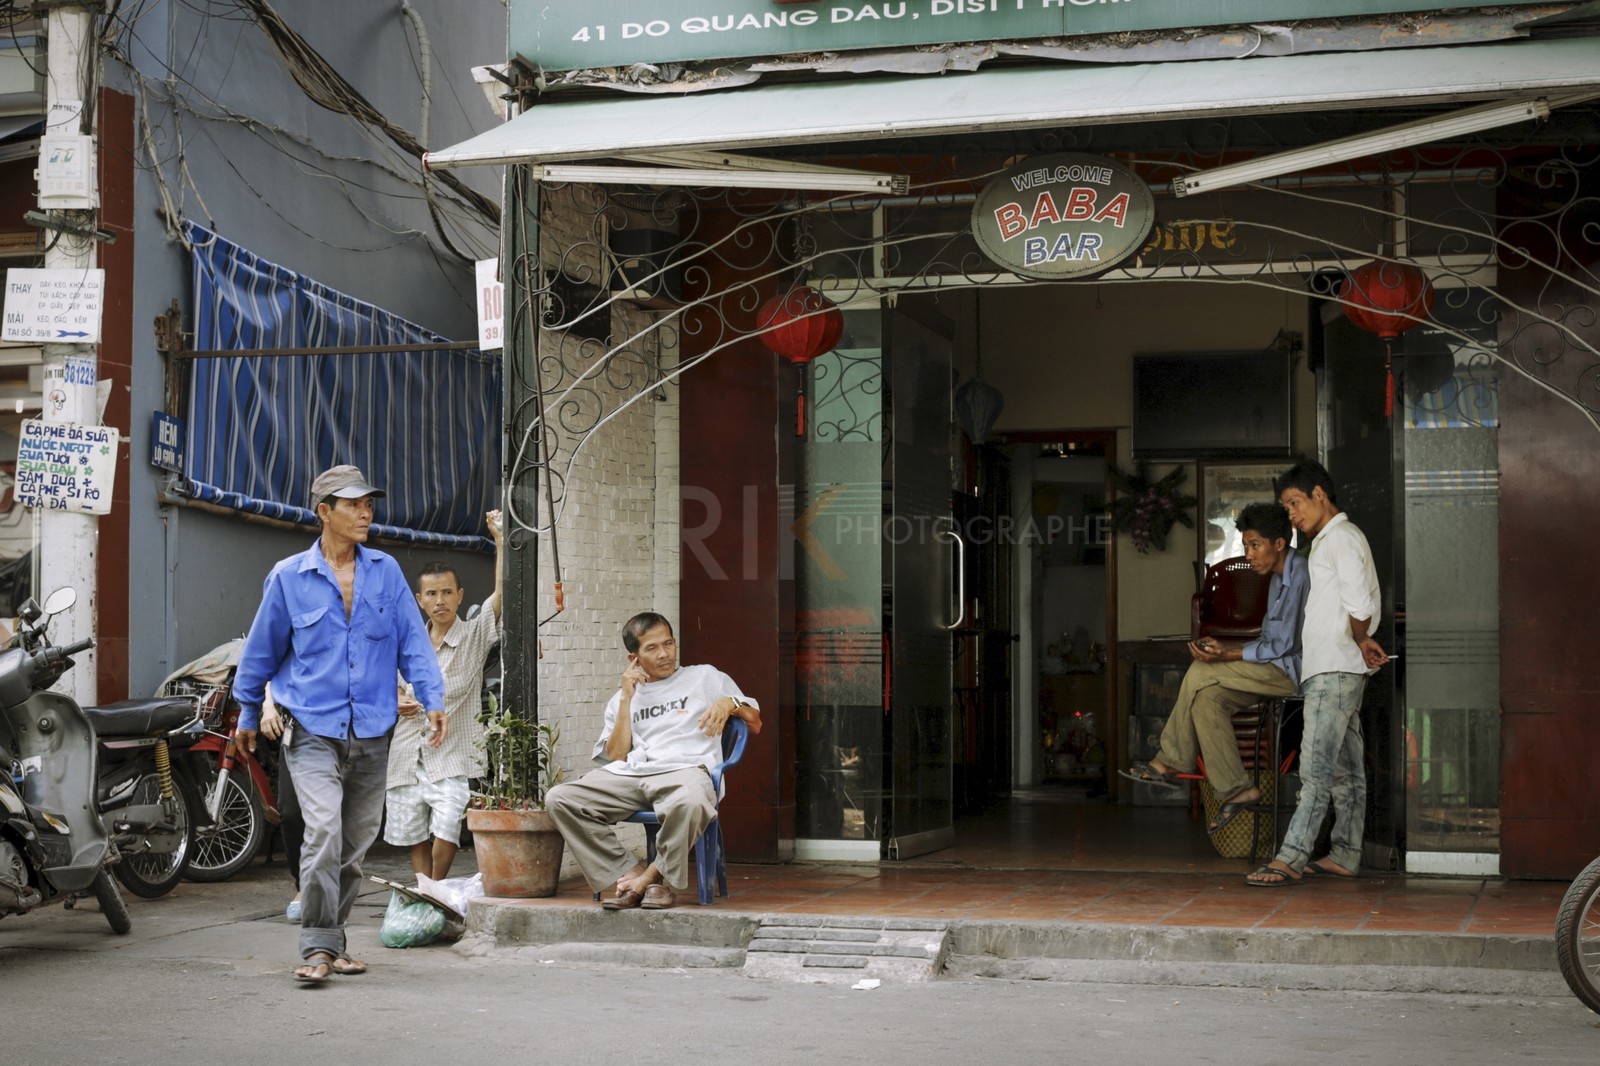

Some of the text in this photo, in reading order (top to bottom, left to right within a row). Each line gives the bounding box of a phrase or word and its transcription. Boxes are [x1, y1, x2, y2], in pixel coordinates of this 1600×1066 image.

[572, 25, 605, 42] 41
[621, 20, 670, 39] DO
[680, 10, 819, 34] QUANG
[1011, 165, 1113, 191] WELCOME
[994, 187, 1130, 242] BABA
[1024, 233, 1103, 266] BAR
[11, 283, 32, 294] THAY
[36, 329, 51, 337] 39/8
[633, 696, 689, 724] MICKEY
